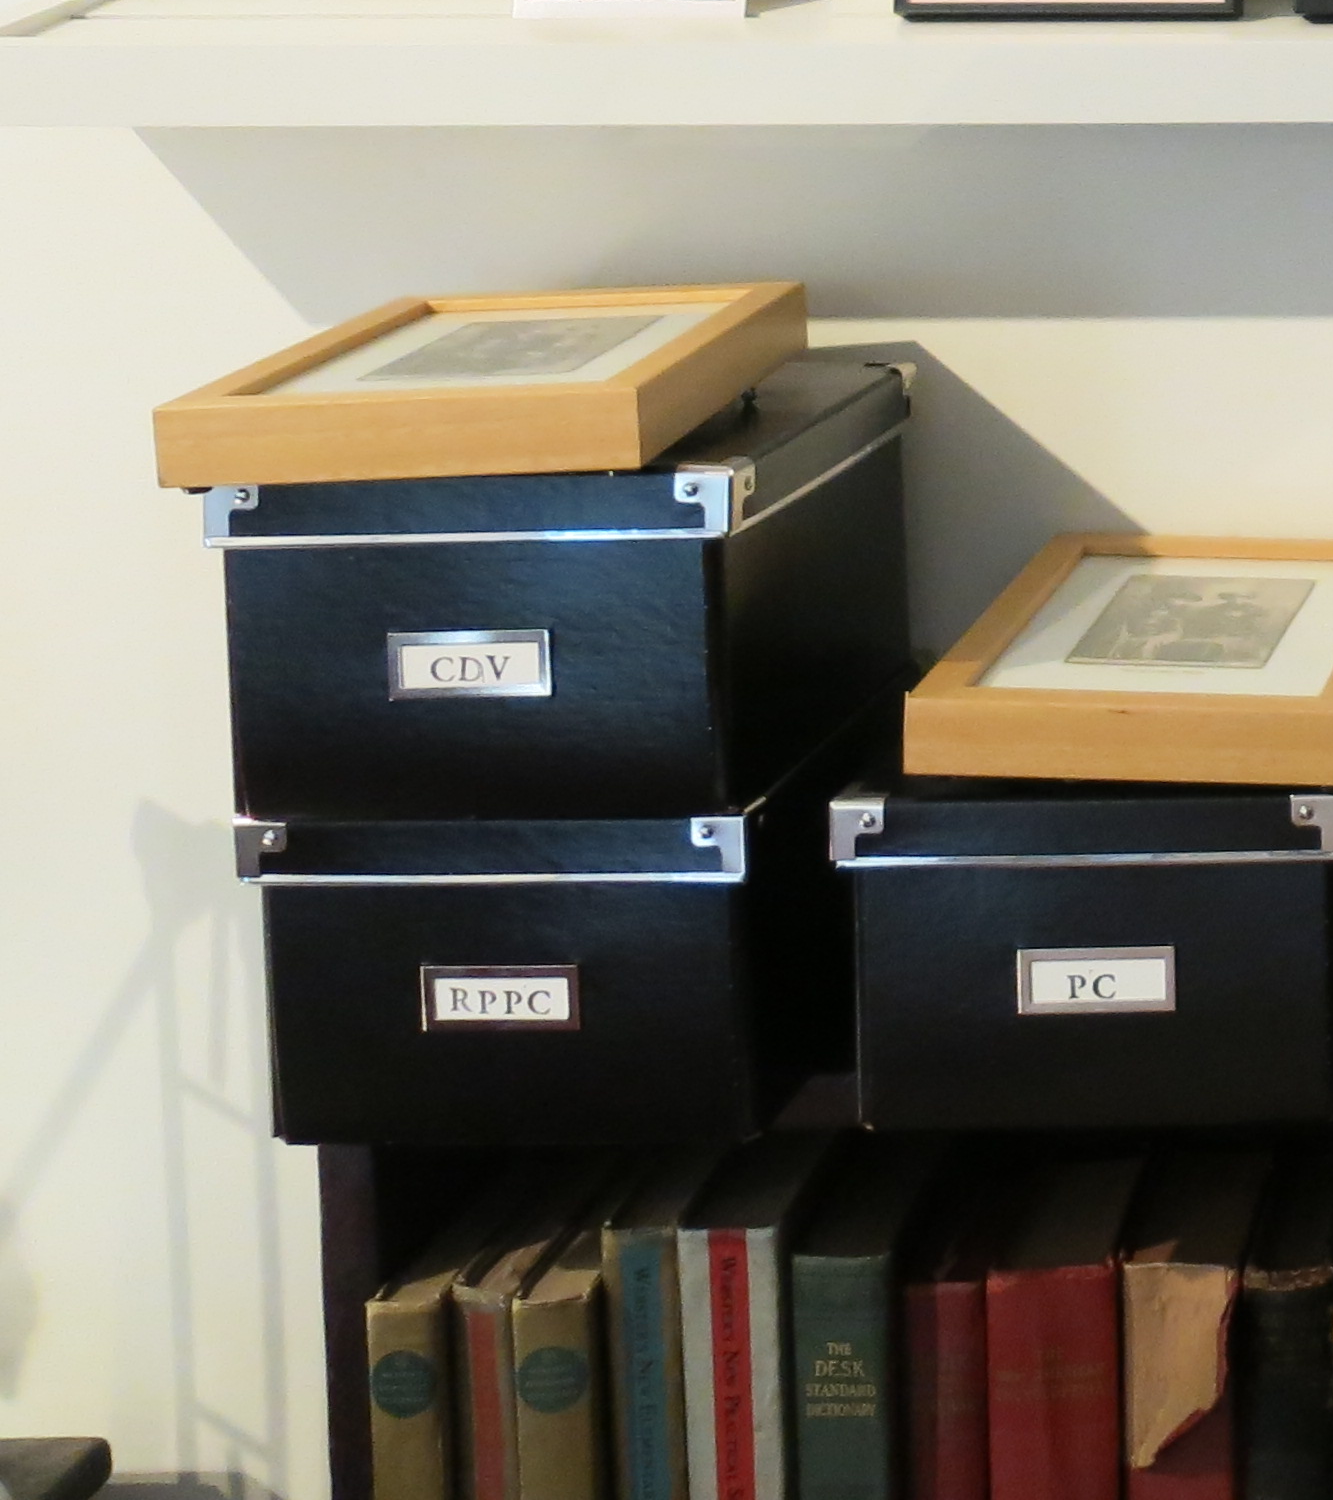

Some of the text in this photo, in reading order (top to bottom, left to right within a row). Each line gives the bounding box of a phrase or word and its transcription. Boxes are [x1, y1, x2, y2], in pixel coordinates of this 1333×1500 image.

[430, 654, 511, 683] CDV
[1067, 974, 1116, 999] PC
[449, 986, 551, 1015] RPPC
[814, 1360, 864, 1377] DESK
[805, 1383, 876, 1397] STANDARD
